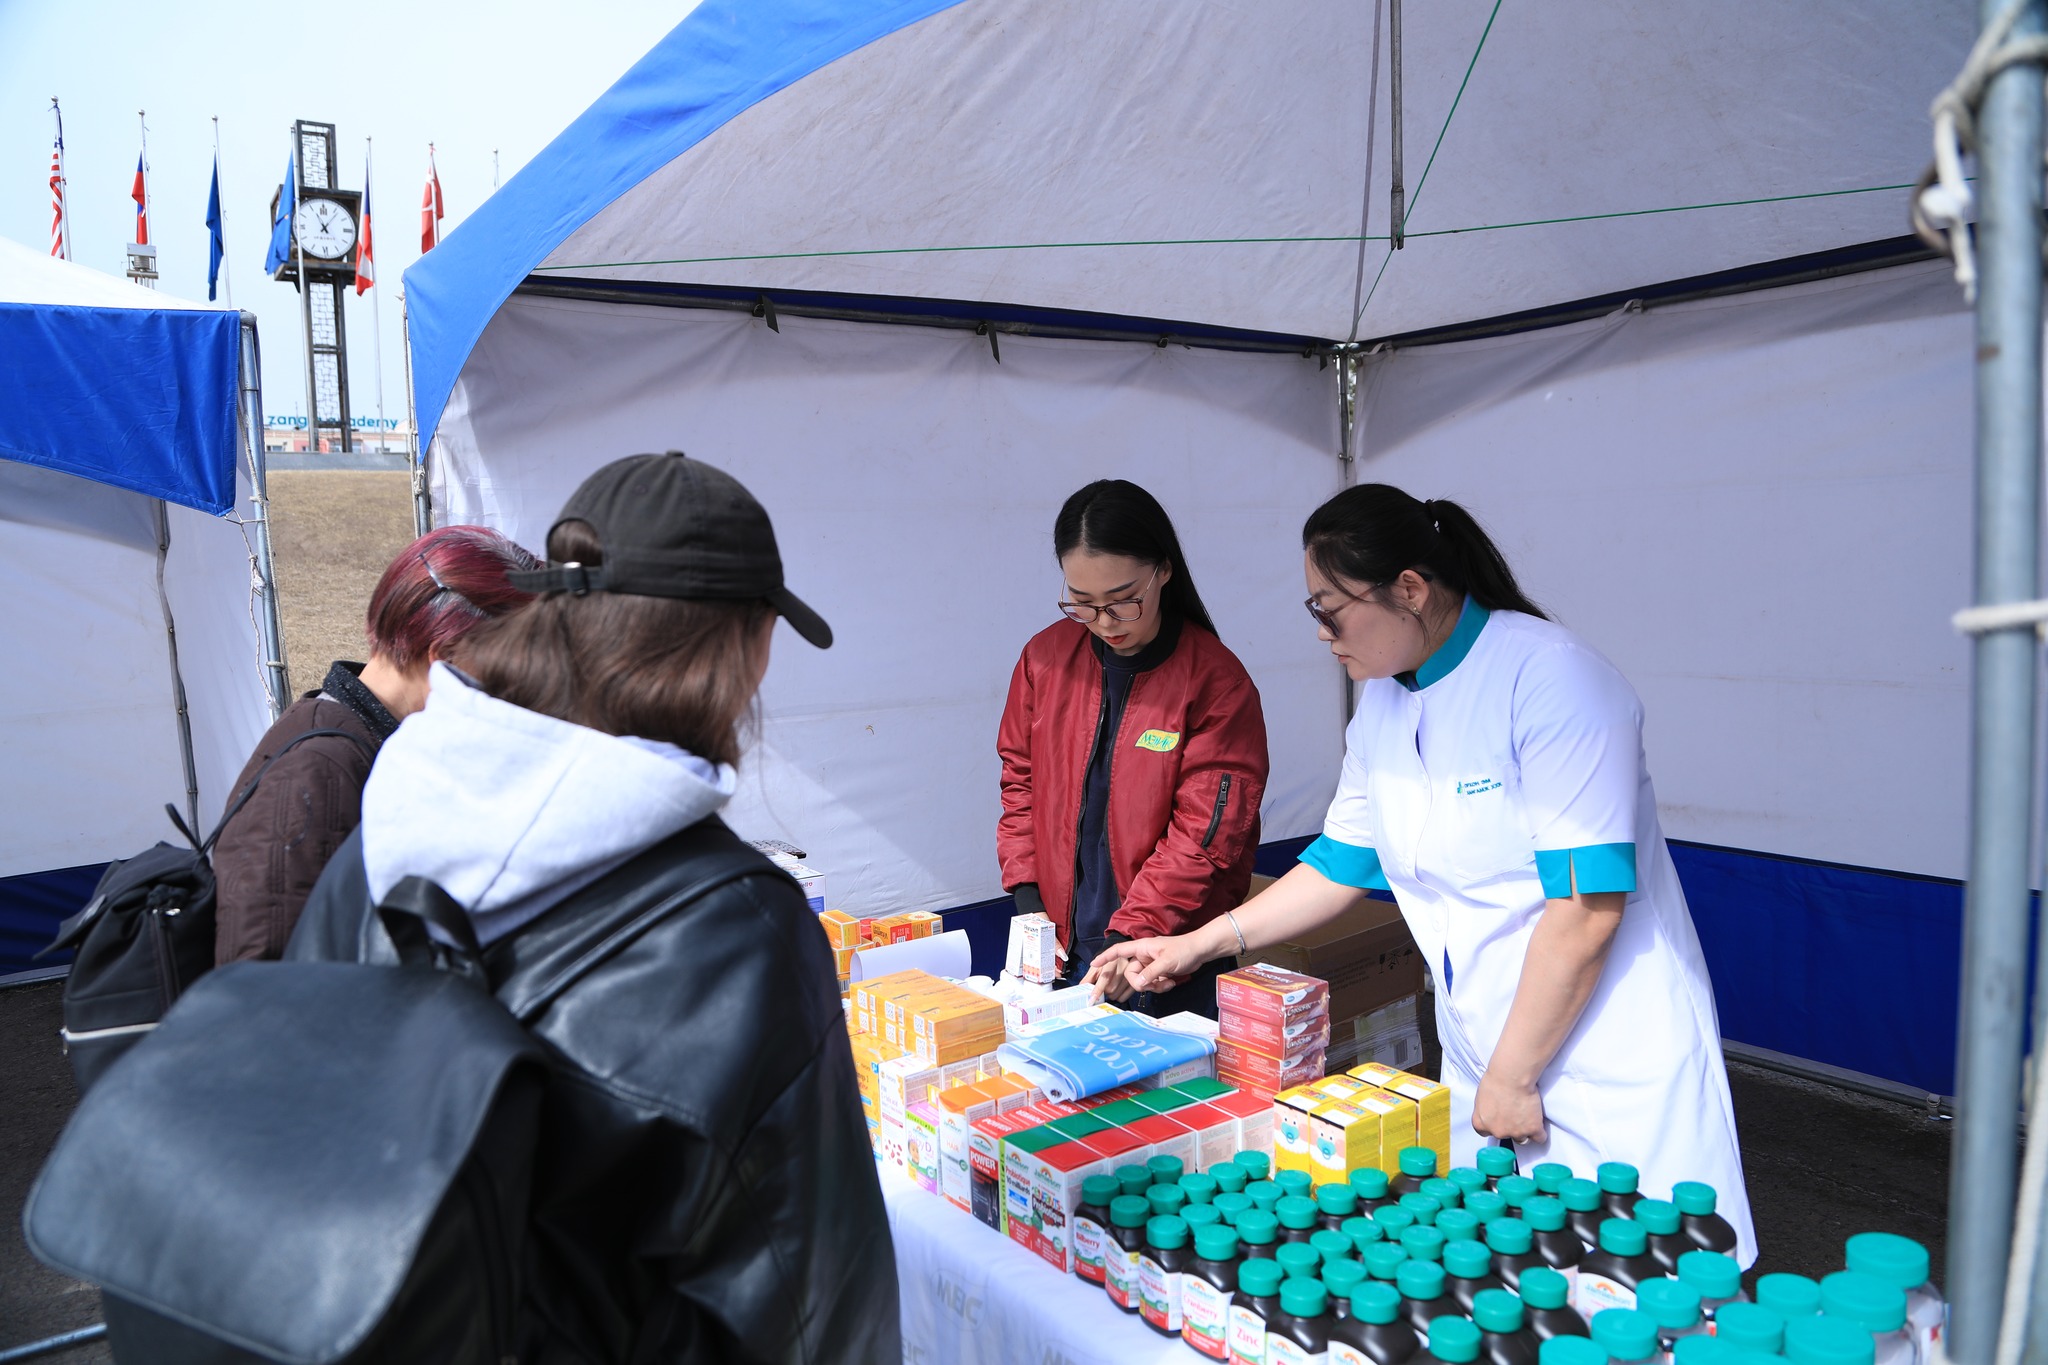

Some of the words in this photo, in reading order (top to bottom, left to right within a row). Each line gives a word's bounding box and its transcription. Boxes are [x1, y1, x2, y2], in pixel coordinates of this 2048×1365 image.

[982, 1118, 1012, 1133] POWER
[970, 1150, 996, 1171] POWER
[1076, 1231, 1100, 1249] Bilberry
[1184, 1294, 1218, 1320] Cranberry
[1236, 1326, 1260, 1348] Zinc
